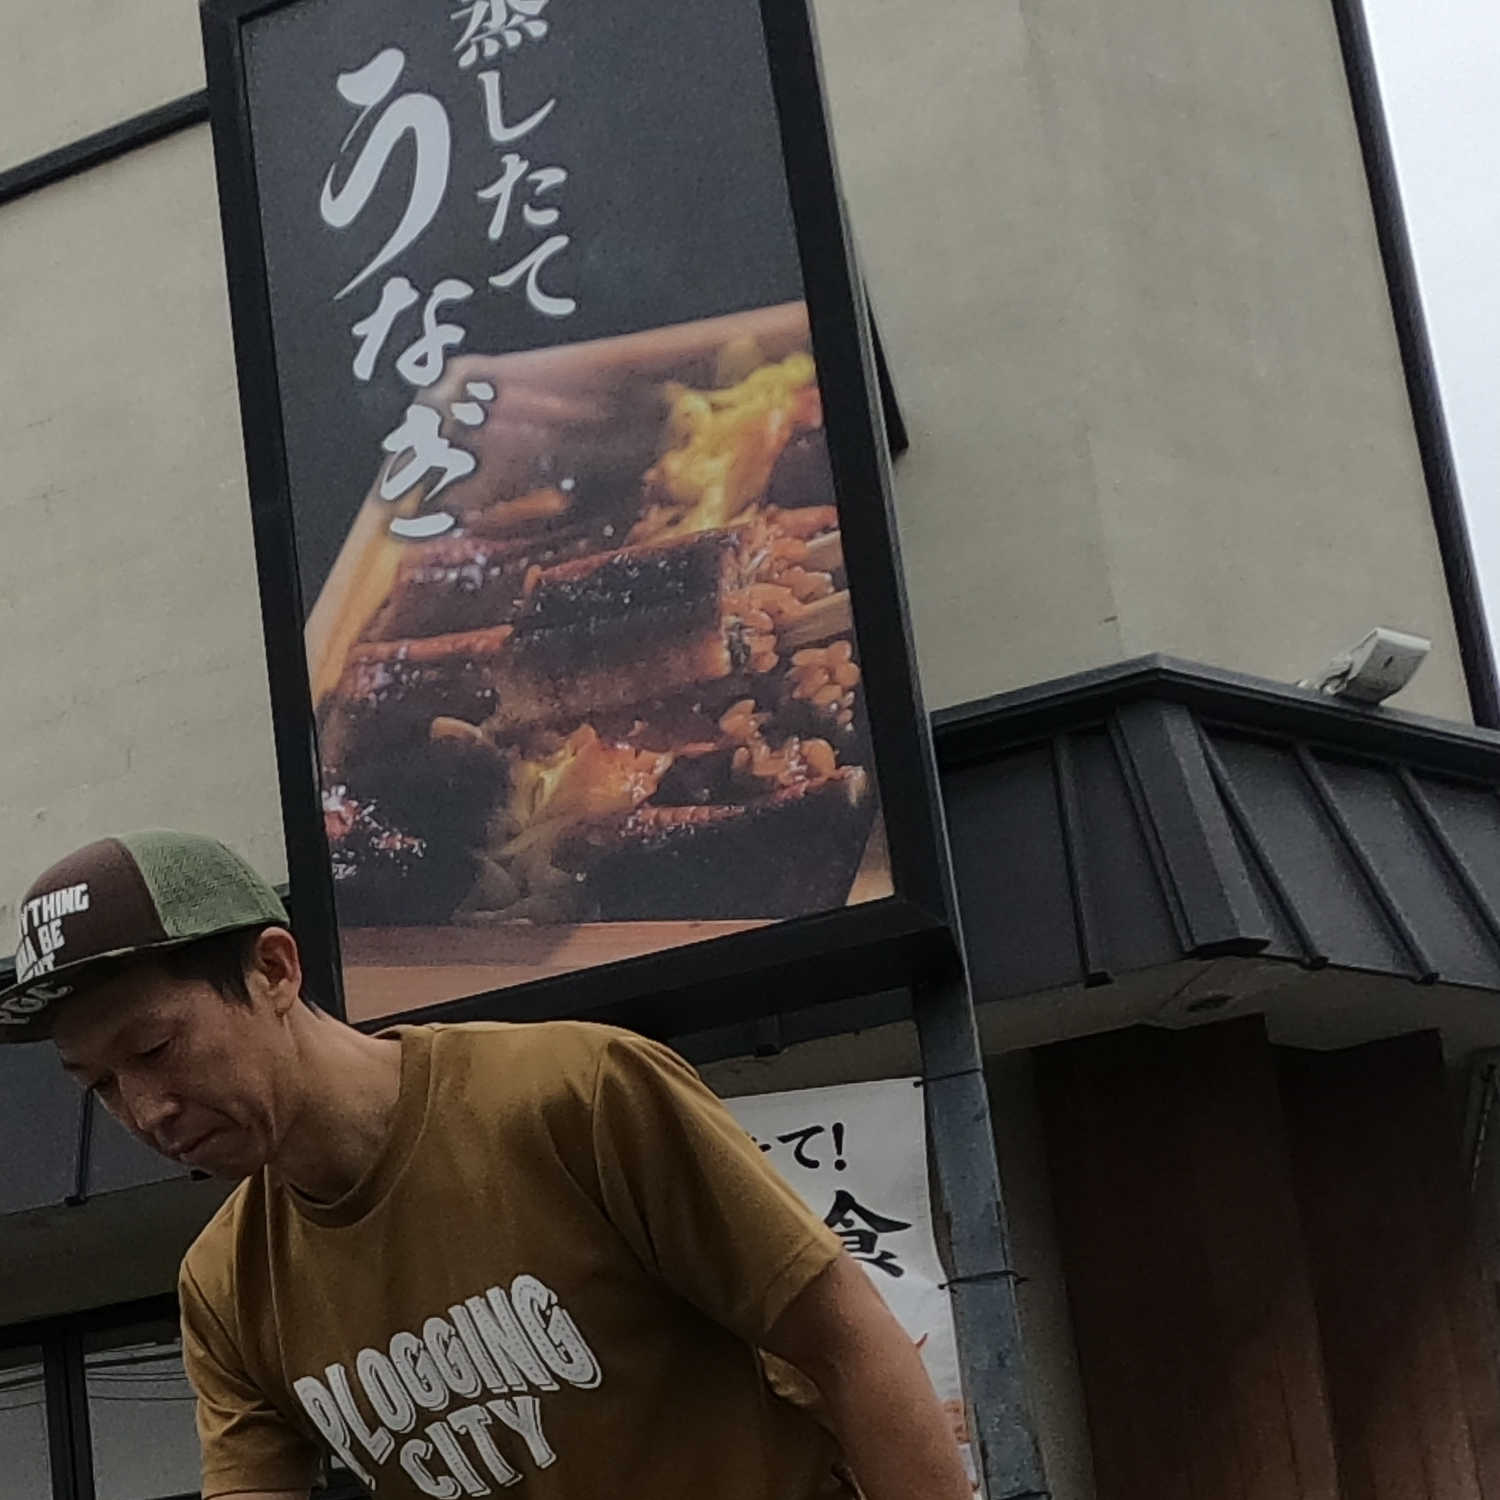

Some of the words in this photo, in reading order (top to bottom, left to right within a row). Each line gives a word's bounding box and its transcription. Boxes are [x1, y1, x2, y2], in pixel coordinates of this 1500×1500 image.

[319, 48, 496, 538] うなぎ
[37, 918, 66, 955] BE
[293, 1274, 602, 1491] PLOGGING
[400, 1396, 557, 1500] CITY
